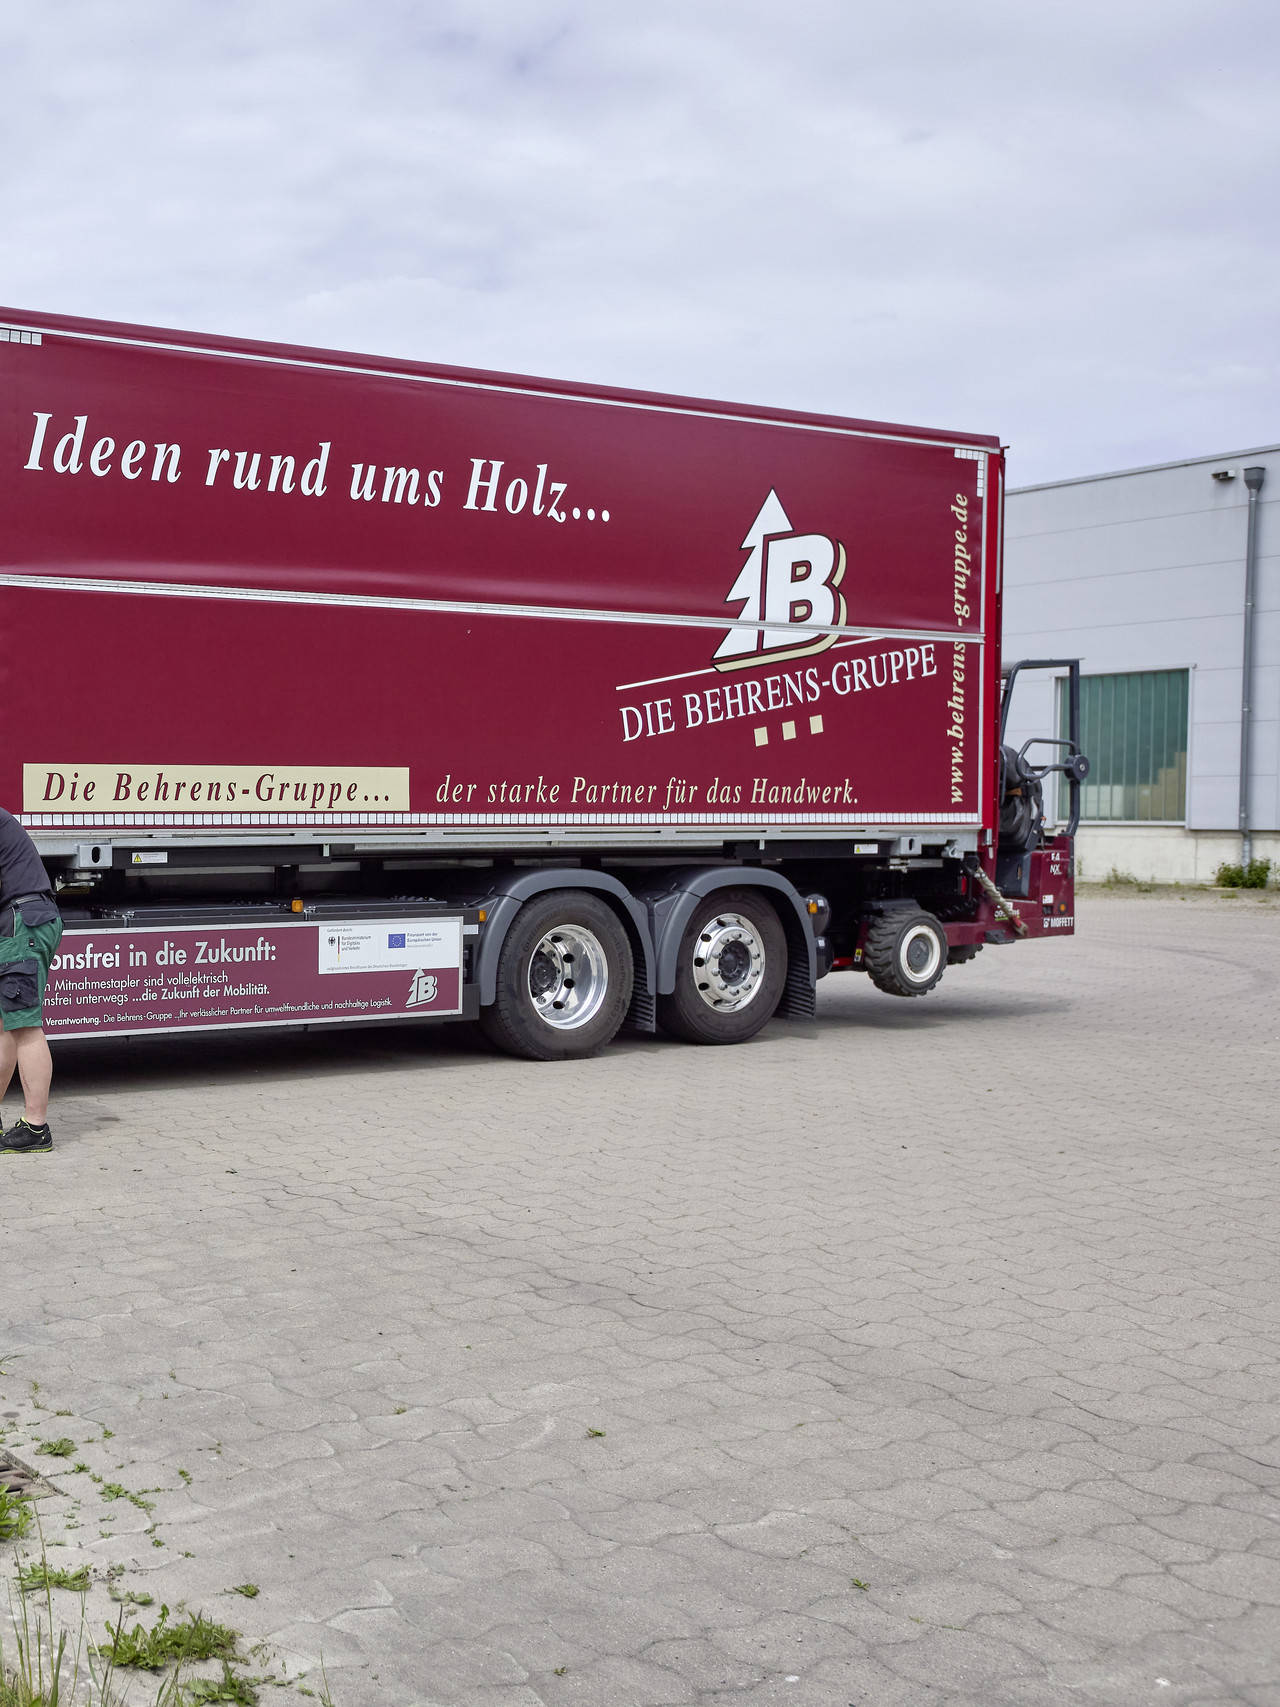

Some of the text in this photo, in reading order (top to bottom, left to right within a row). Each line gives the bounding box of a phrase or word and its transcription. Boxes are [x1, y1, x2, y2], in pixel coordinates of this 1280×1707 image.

[23, 411, 611, 523] Ideen rund ums Holz...
[947, 493, 972, 804] www.behrens-gruppe.de
[619, 643, 938, 742] DIE BEHRENS-GRUPPE
[42, 772, 390, 809] Die Behrens-Gruppe...
[436, 774, 858, 810] der starke Partner für das Handwerk.
[1050, 917, 1074, 927] MOFFETT
[129, 943, 147, 967] in
[155, 940, 187, 965] die
[194, 936, 276, 964] Zukunft:
[54, 974, 140, 992] Mitnahmestapler
[143, 973, 164, 988] sind
[167, 970, 228, 986] vollelektrisch
[75, 993, 128, 1006] unterwegs
[161, 986, 200, 1000] Zukunft
[203, 985, 220, 998] der
[223, 983, 270, 997] Mobilität.
[45, 1014, 101, 1027] Verantwortung.
[103, 1013, 115, 1023] Die
[116, 1010, 172, 1023] Behrens-Gruppe
[190, 1005, 229, 1018] verlässlicher
[230, 1006, 253, 1016] Partner
[254, 1004, 263, 1014] für
[265, 1001, 319, 1013] umweltfreundliche
[321, 1000, 333, 1010] und
[334, 998, 368, 1010] nachhaltige
